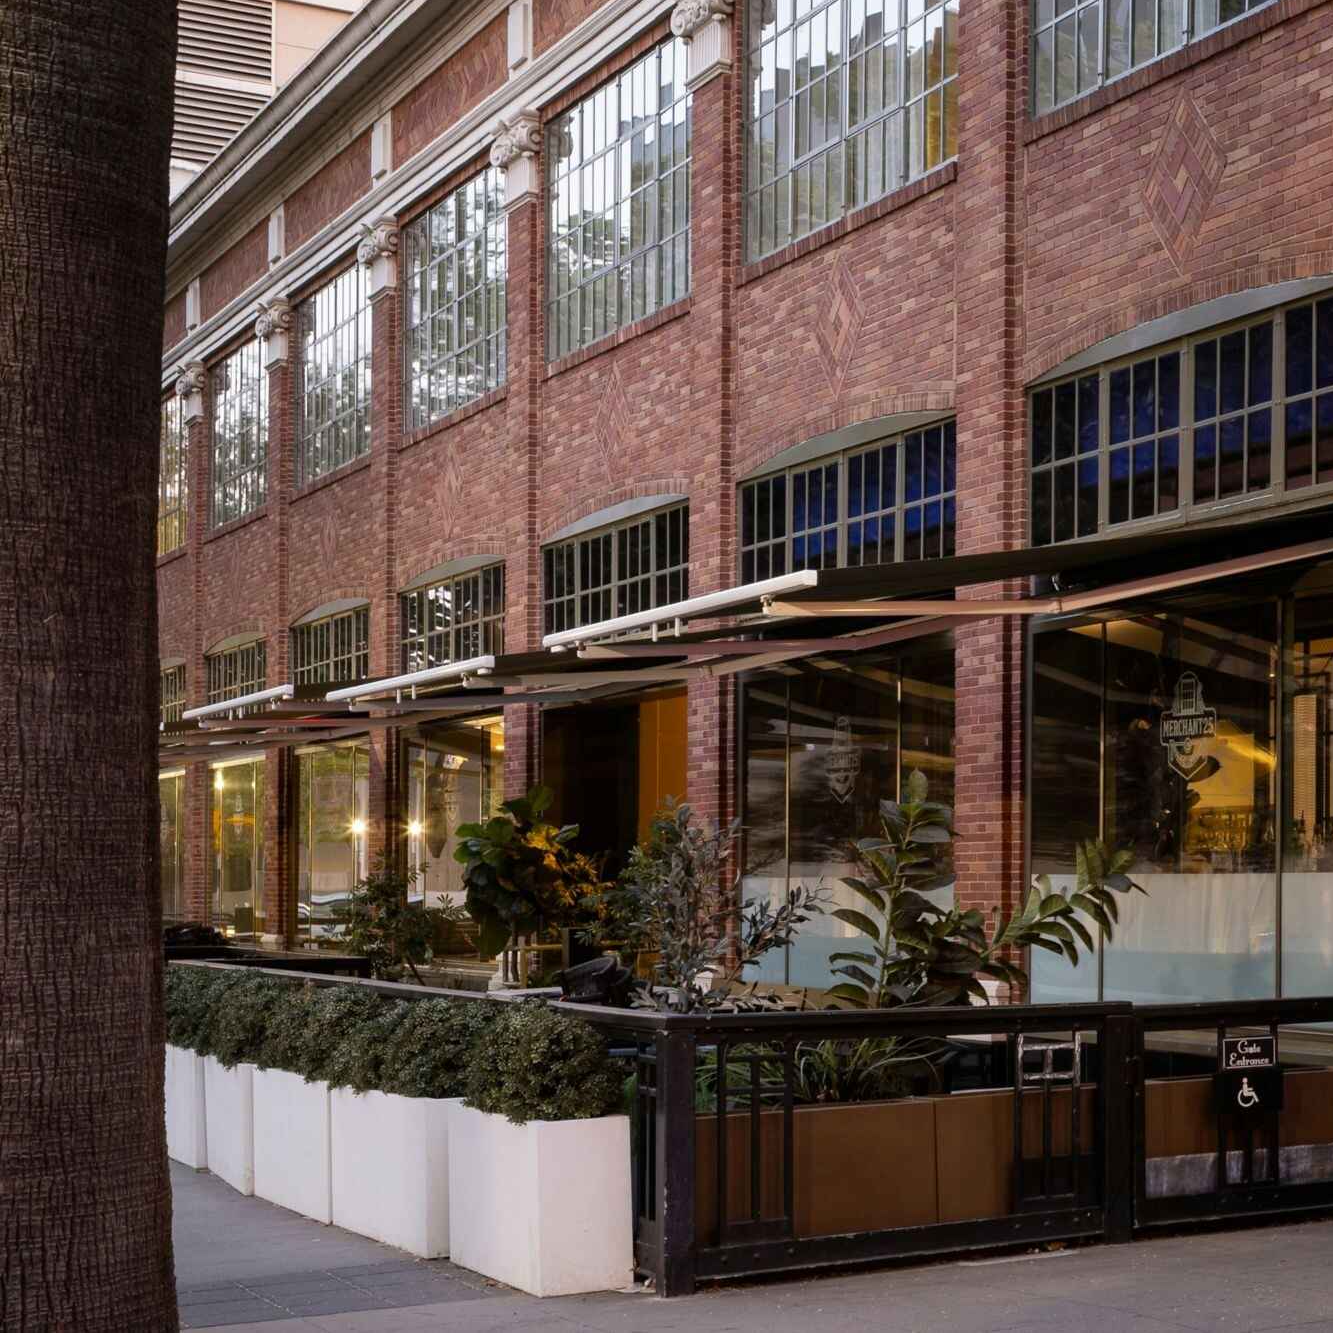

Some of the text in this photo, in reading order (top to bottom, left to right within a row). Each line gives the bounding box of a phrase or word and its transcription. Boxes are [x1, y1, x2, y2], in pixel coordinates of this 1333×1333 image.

[1163, 717, 1214, 737] MERCHANT25
[1238, 1040, 1261, 1054] Gate
[1230, 1053, 1270, 1066] Entrance
